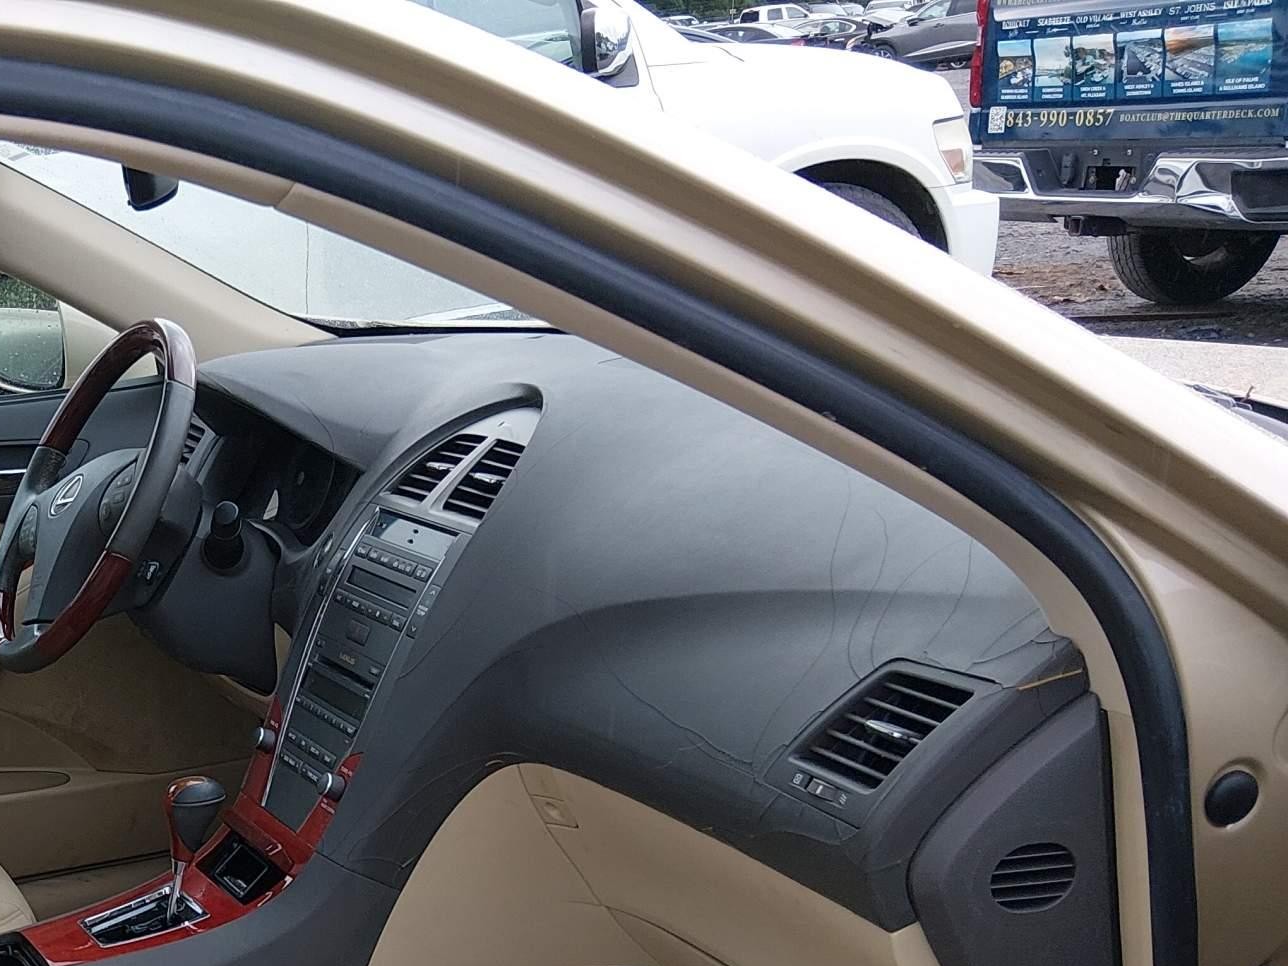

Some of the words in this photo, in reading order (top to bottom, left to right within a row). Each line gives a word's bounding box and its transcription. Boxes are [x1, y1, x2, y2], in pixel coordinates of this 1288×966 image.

[1184, 2, 1216, 14] JOHNS
[1006, 109, 1115, 127] 843-990-0857
[1119, 108, 1280, 122] BOATCLUB@THEQUARTERDECK.COM
